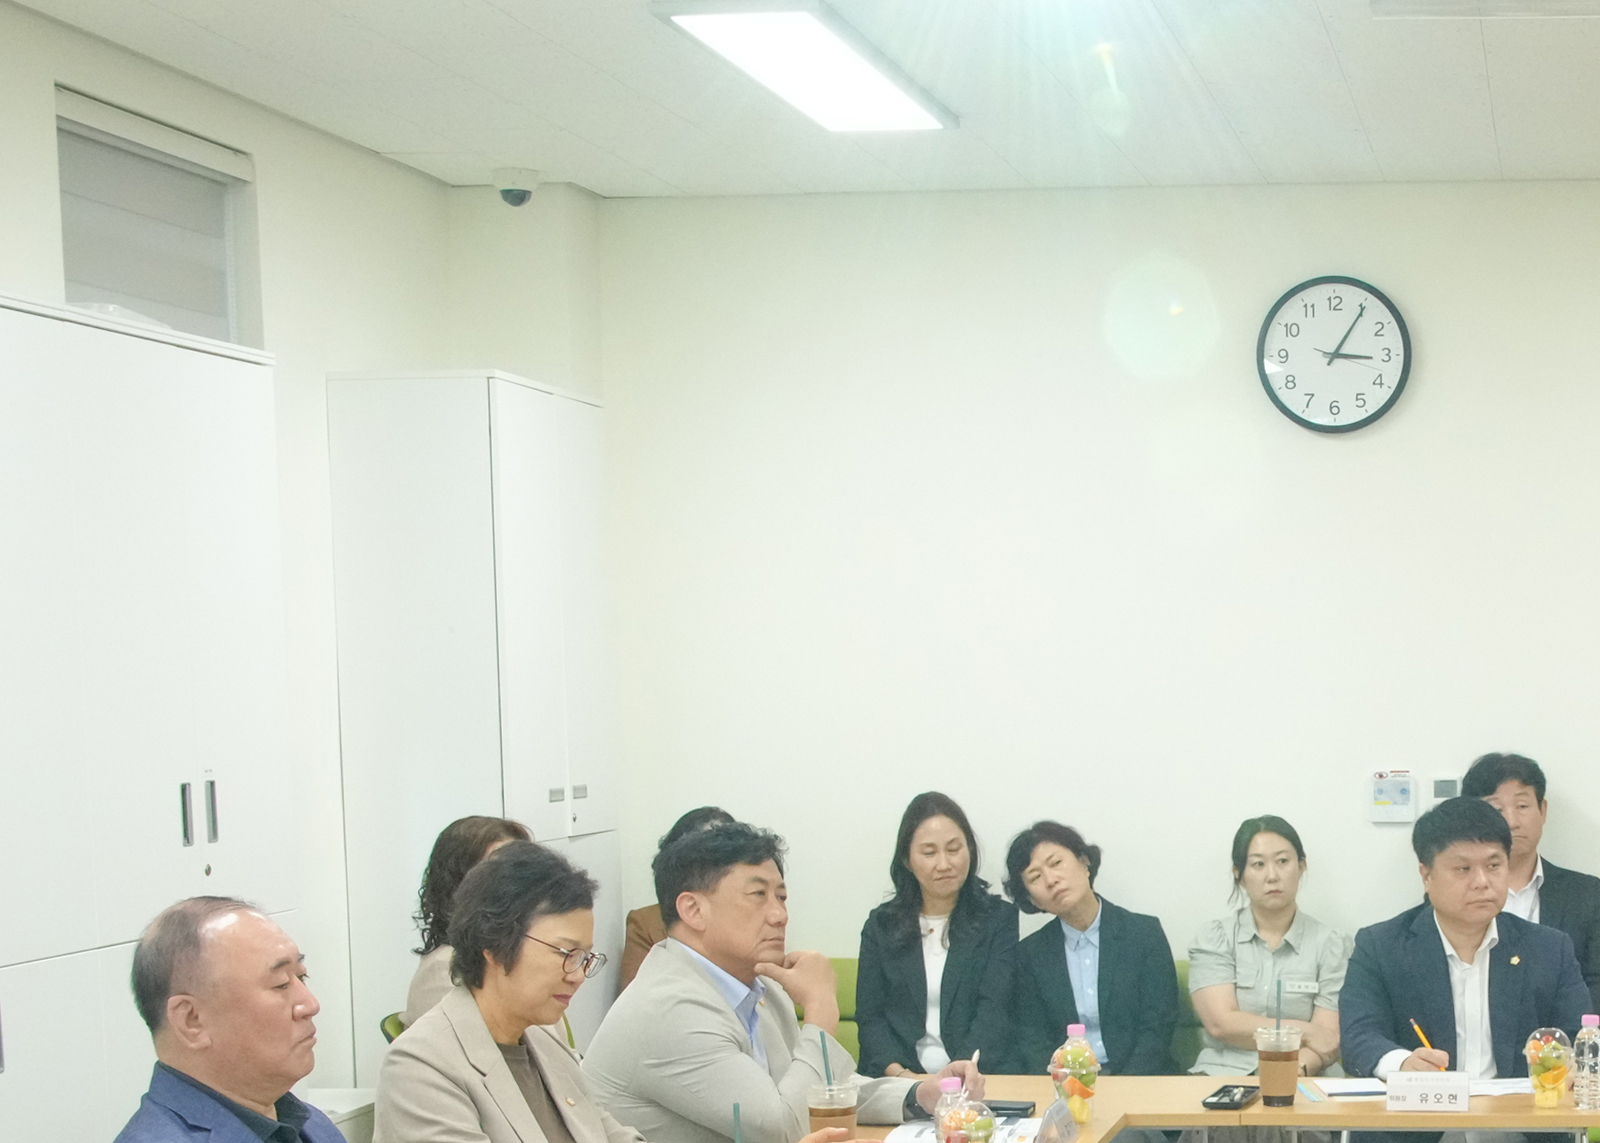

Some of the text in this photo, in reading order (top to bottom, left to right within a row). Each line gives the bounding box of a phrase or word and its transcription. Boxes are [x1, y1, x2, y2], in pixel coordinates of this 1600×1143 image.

[1303, 303, 1315, 318] 11
[1327, 296, 1343, 311] 12
[1284, 322, 1300, 337] 10
[1374, 321, 1385, 336] 2
[1277, 348, 1289, 363] 9
[1381, 347, 1391, 362] 3
[1284, 374, 1296, 389] 8
[1372, 373, 1384, 388] 4
[1304, 393, 1315, 408] 7
[1329, 400, 1340, 415] 6
[1355, 393, 1366, 408] 5
